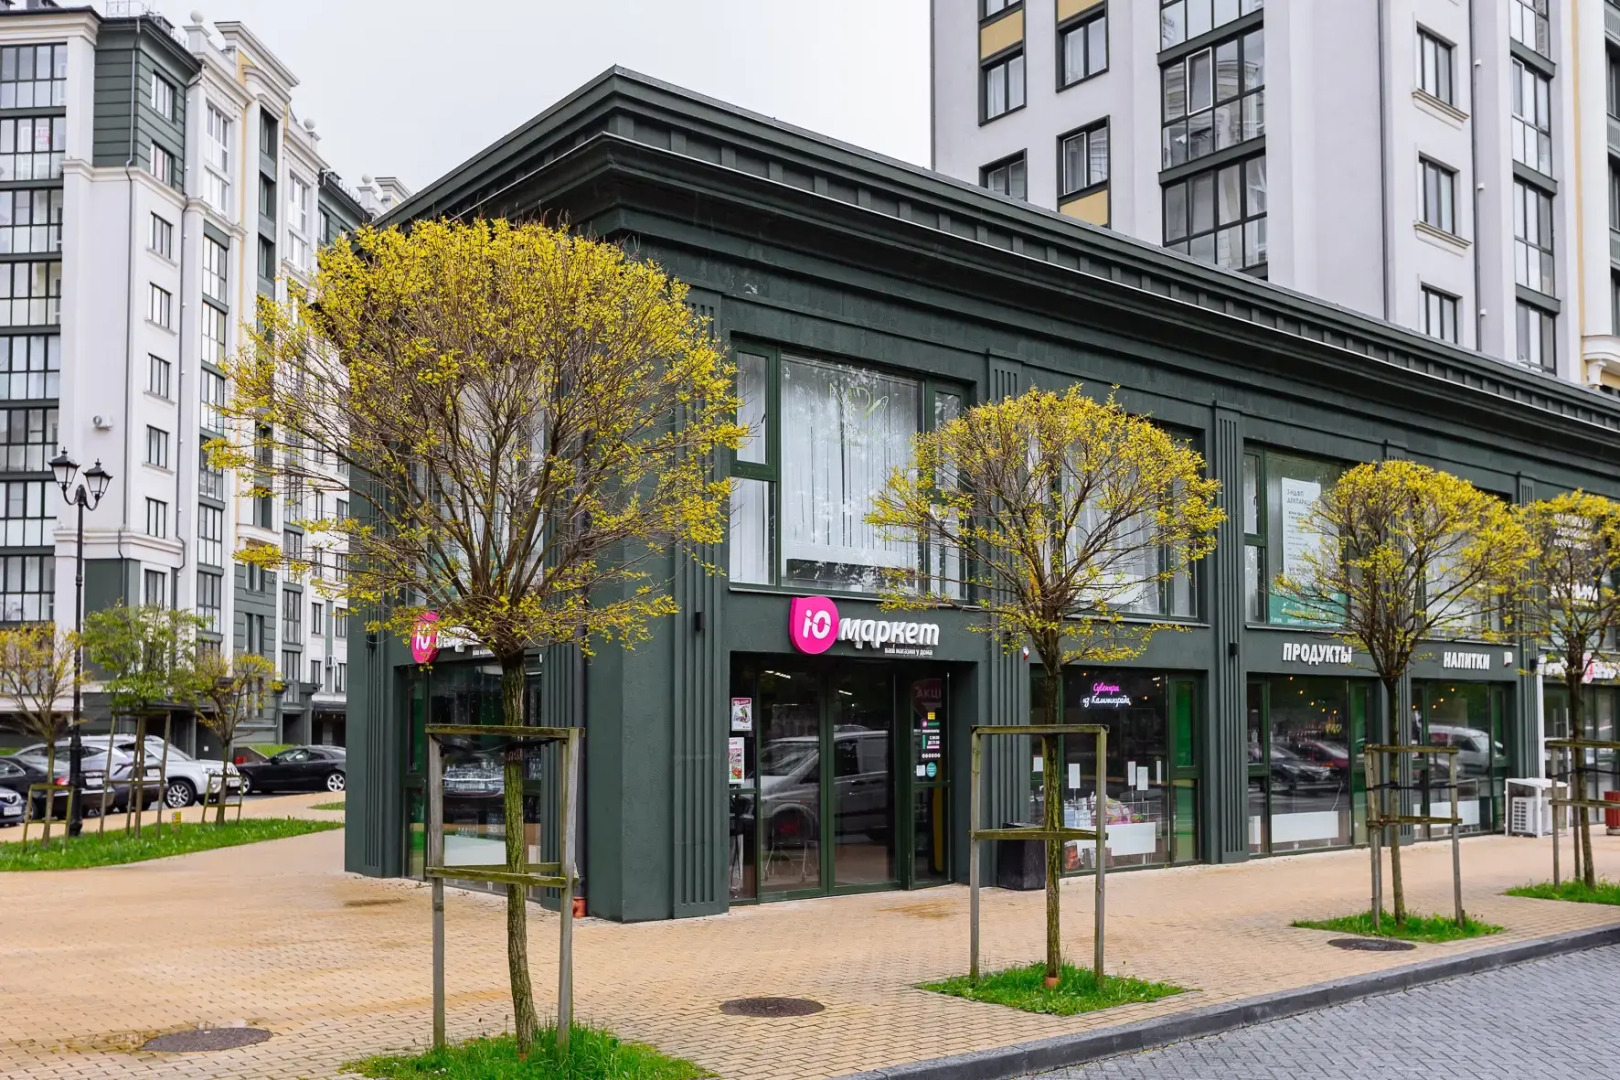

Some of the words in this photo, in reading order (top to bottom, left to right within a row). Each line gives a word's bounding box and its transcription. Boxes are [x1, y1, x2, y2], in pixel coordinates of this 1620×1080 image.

[838, 618, 940, 649] маркет
[1282, 642, 1352, 666] ПРОДУКТЫ
[1443, 651, 1490, 670] НАПИТКИ
[1082, 697, 1090, 708] из
